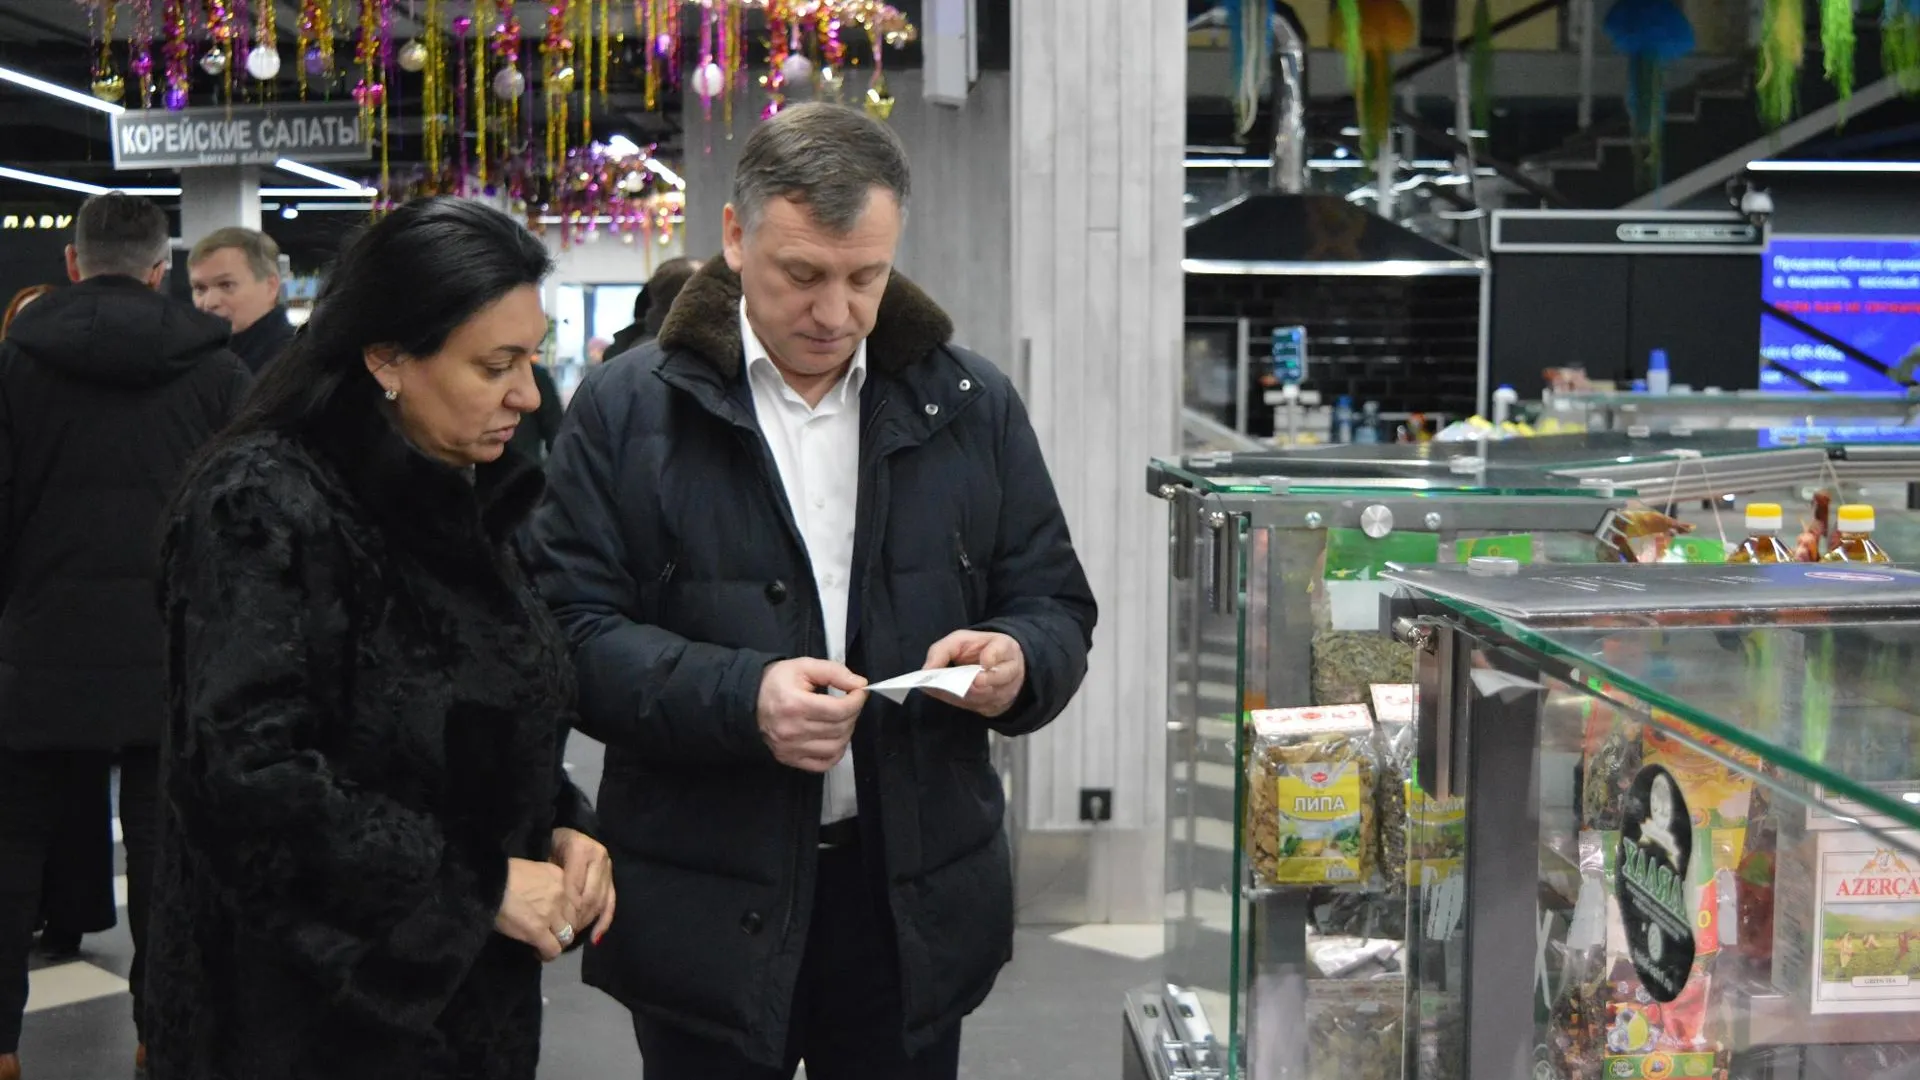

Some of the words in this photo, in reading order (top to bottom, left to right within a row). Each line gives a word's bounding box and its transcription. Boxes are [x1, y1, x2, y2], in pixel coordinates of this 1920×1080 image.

[121, 117, 252, 154] КОРЕЙСКИЕ
[258, 115, 361, 150] САЛАТЫ
[1293, 795, 1347, 812] ЛИПА
[1835, 877, 1920, 899] AZERÇA
